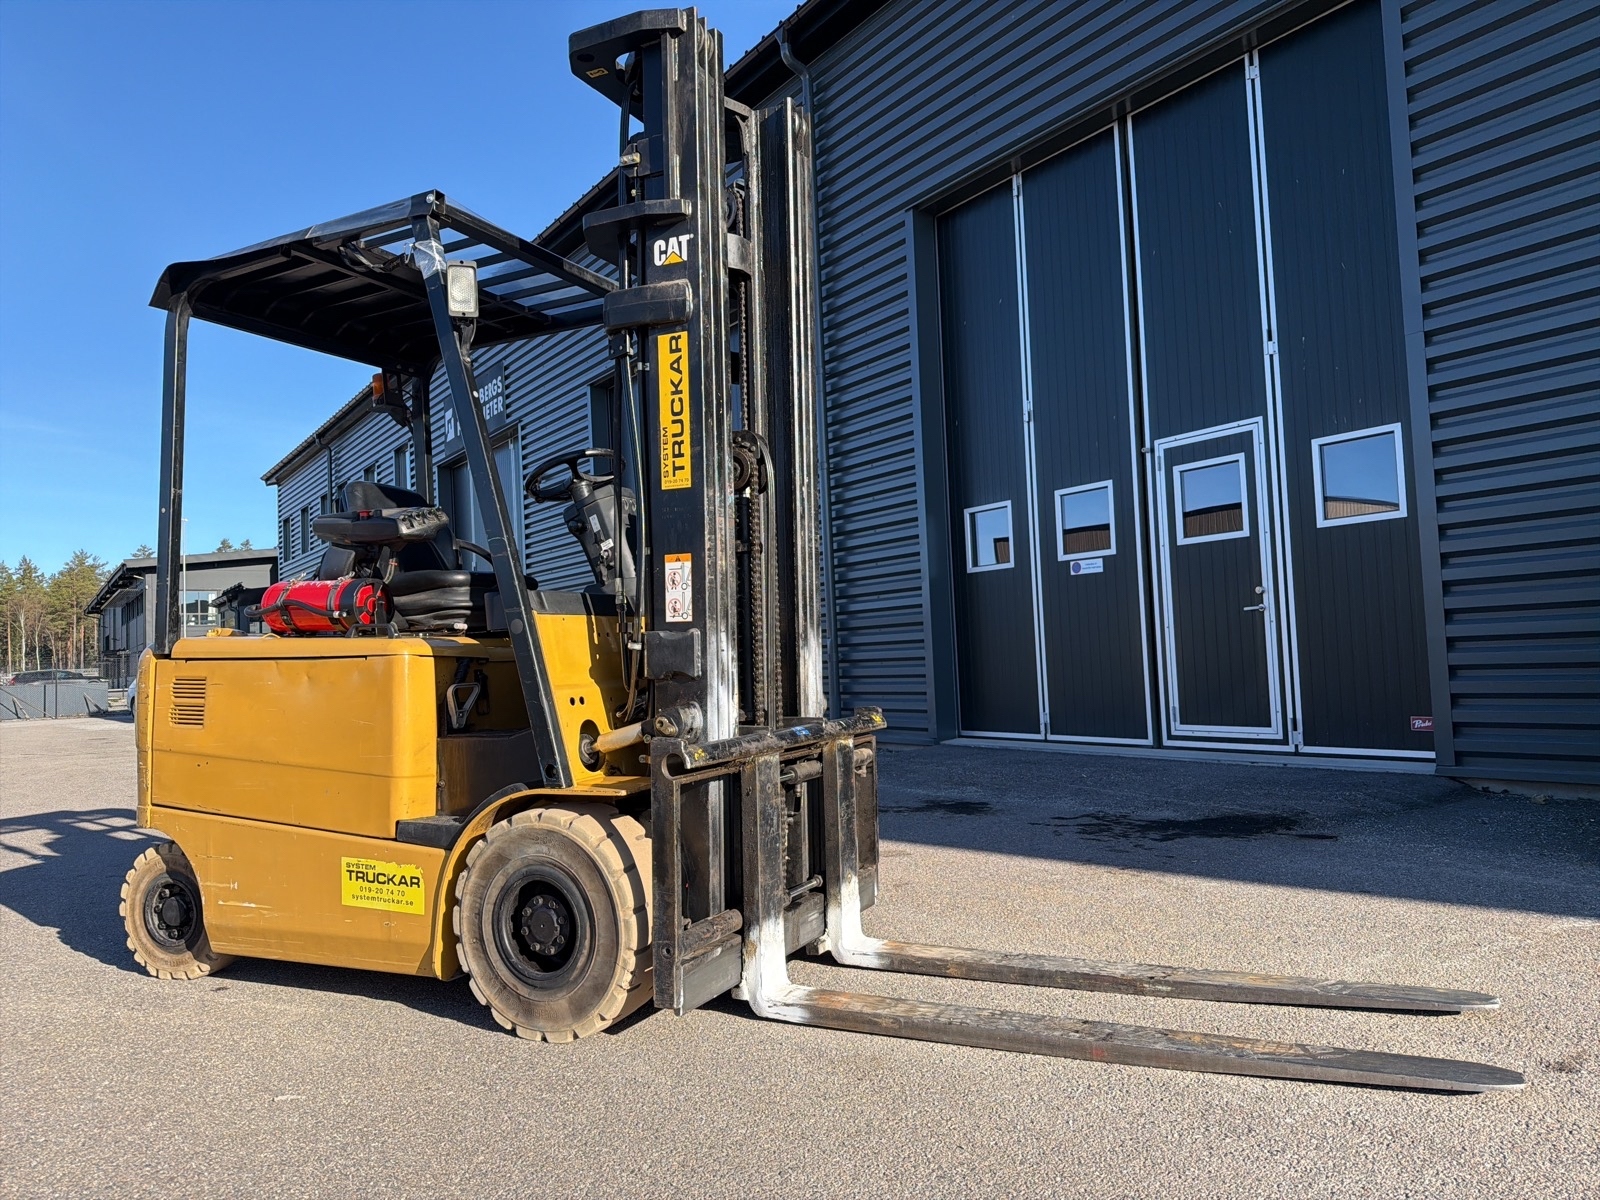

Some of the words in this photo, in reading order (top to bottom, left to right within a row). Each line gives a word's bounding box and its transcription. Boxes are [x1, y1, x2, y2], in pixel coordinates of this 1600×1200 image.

[653, 234, 690, 267] CAT
[669, 334, 685, 477] TRUCKAR
[345, 862, 376, 871] SYSTEM
[346, 869, 421, 888] TRUCKAR
[359, 885, 383, 895] 019-20
[396, 889, 406, 897] 70
[351, 893, 414, 906] systemtruckar.se
